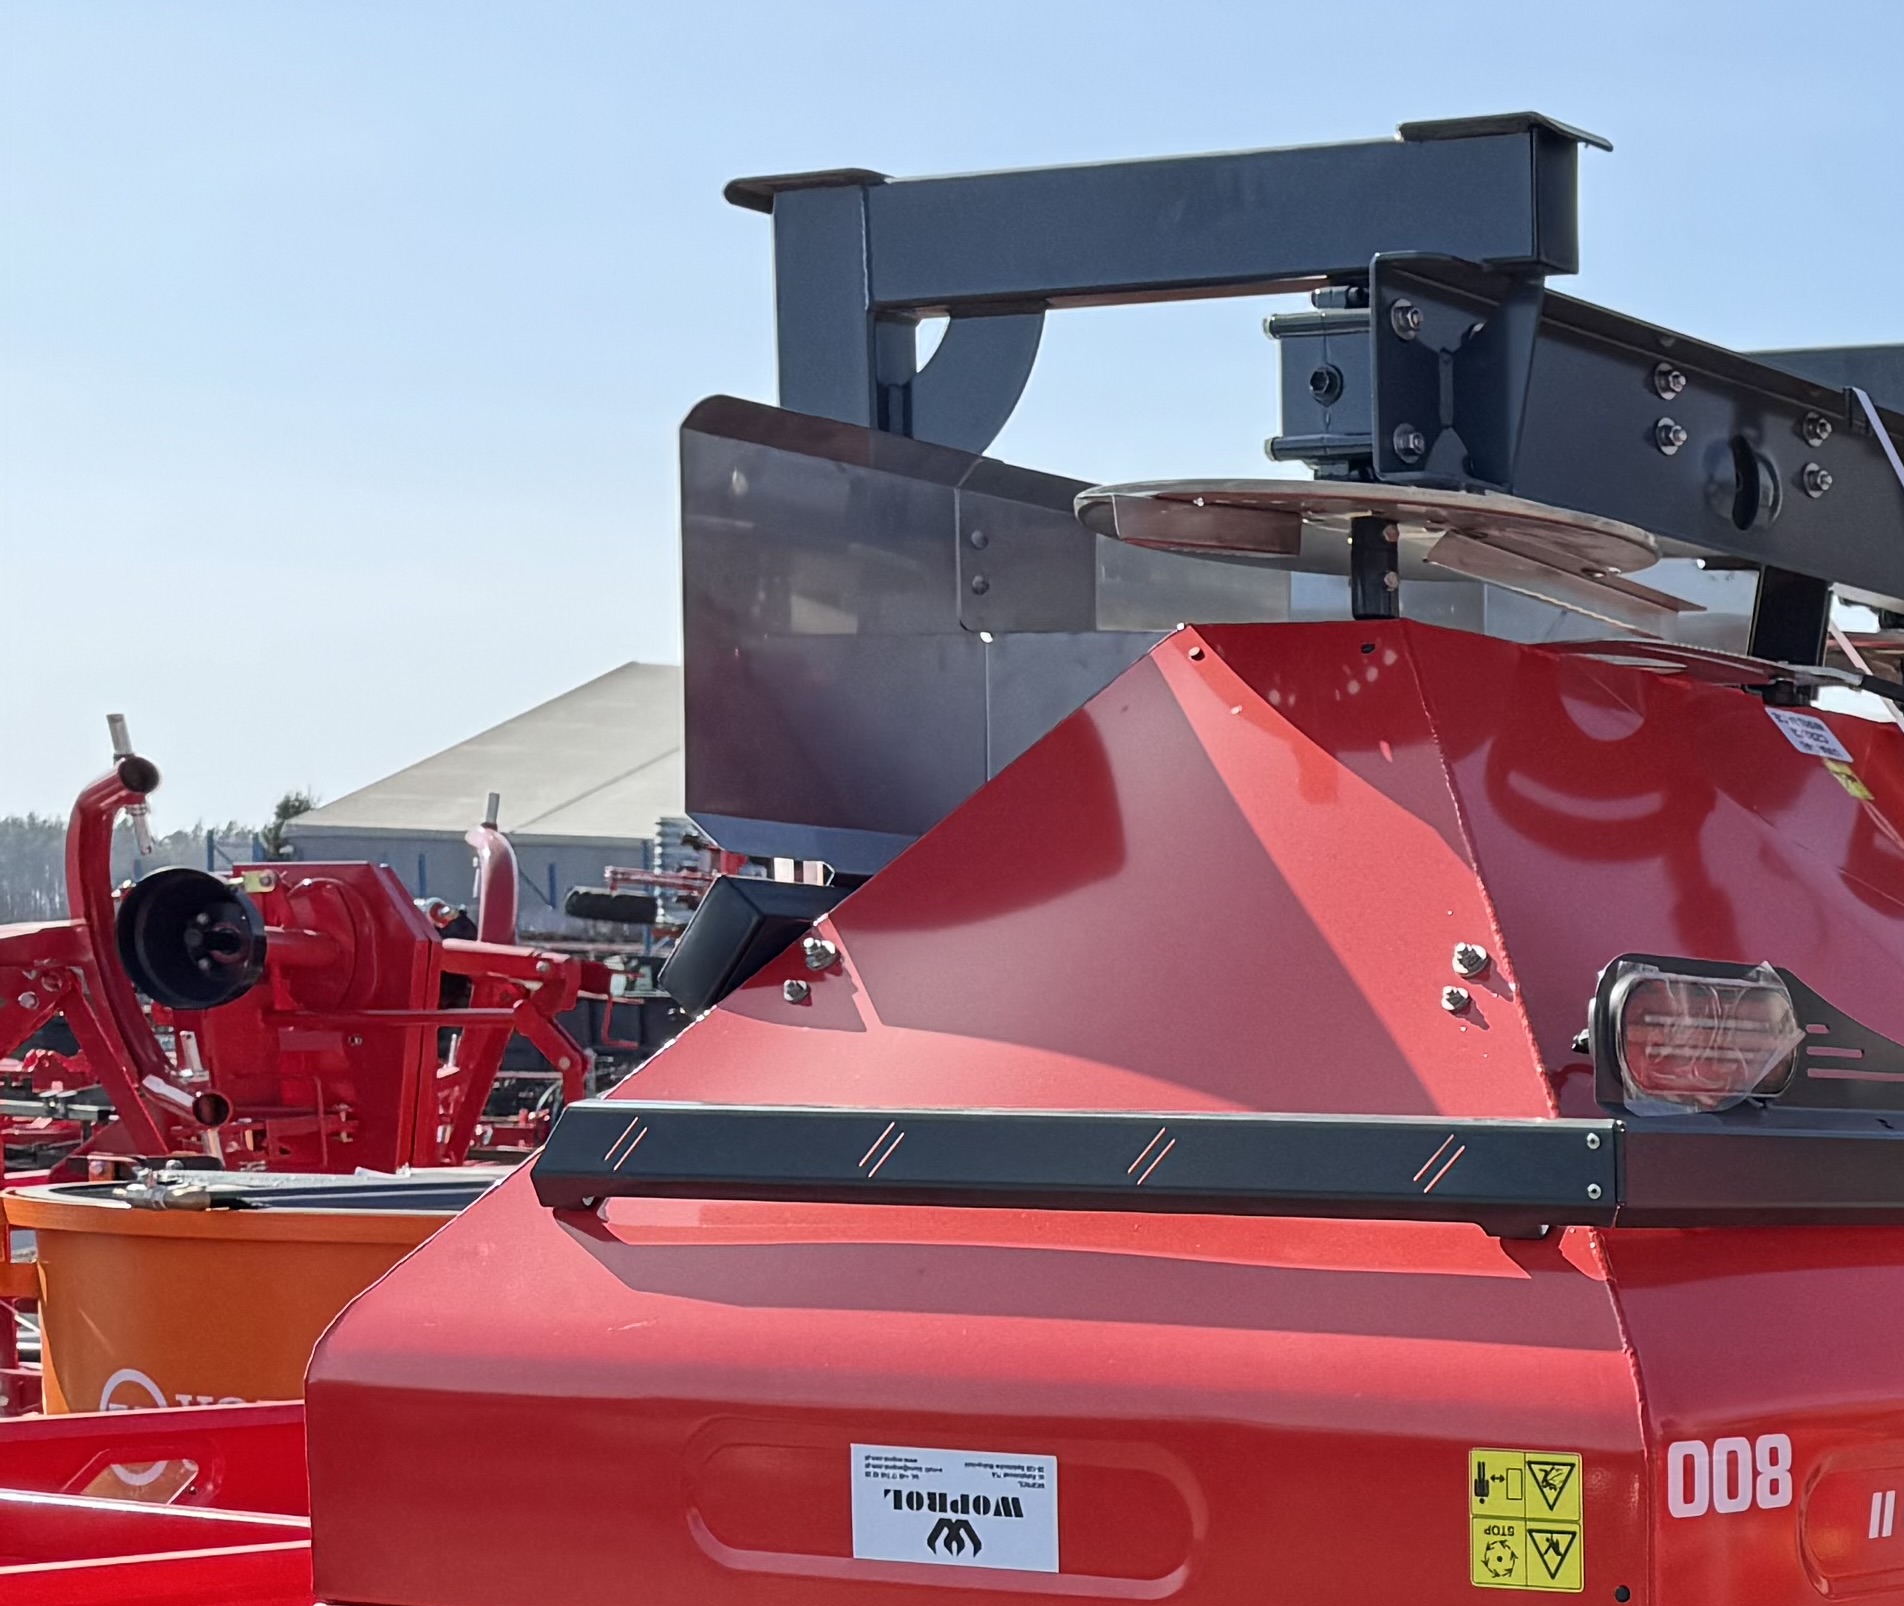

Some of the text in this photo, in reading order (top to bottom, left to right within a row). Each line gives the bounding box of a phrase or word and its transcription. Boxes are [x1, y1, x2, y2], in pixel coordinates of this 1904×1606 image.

[1668, 1434, 1792, 1518] 800
[884, 1489, 1023, 1519] WOPROL
[1868, 1490, 1896, 1539] II
[1484, 1525, 1514, 1536] STOP
